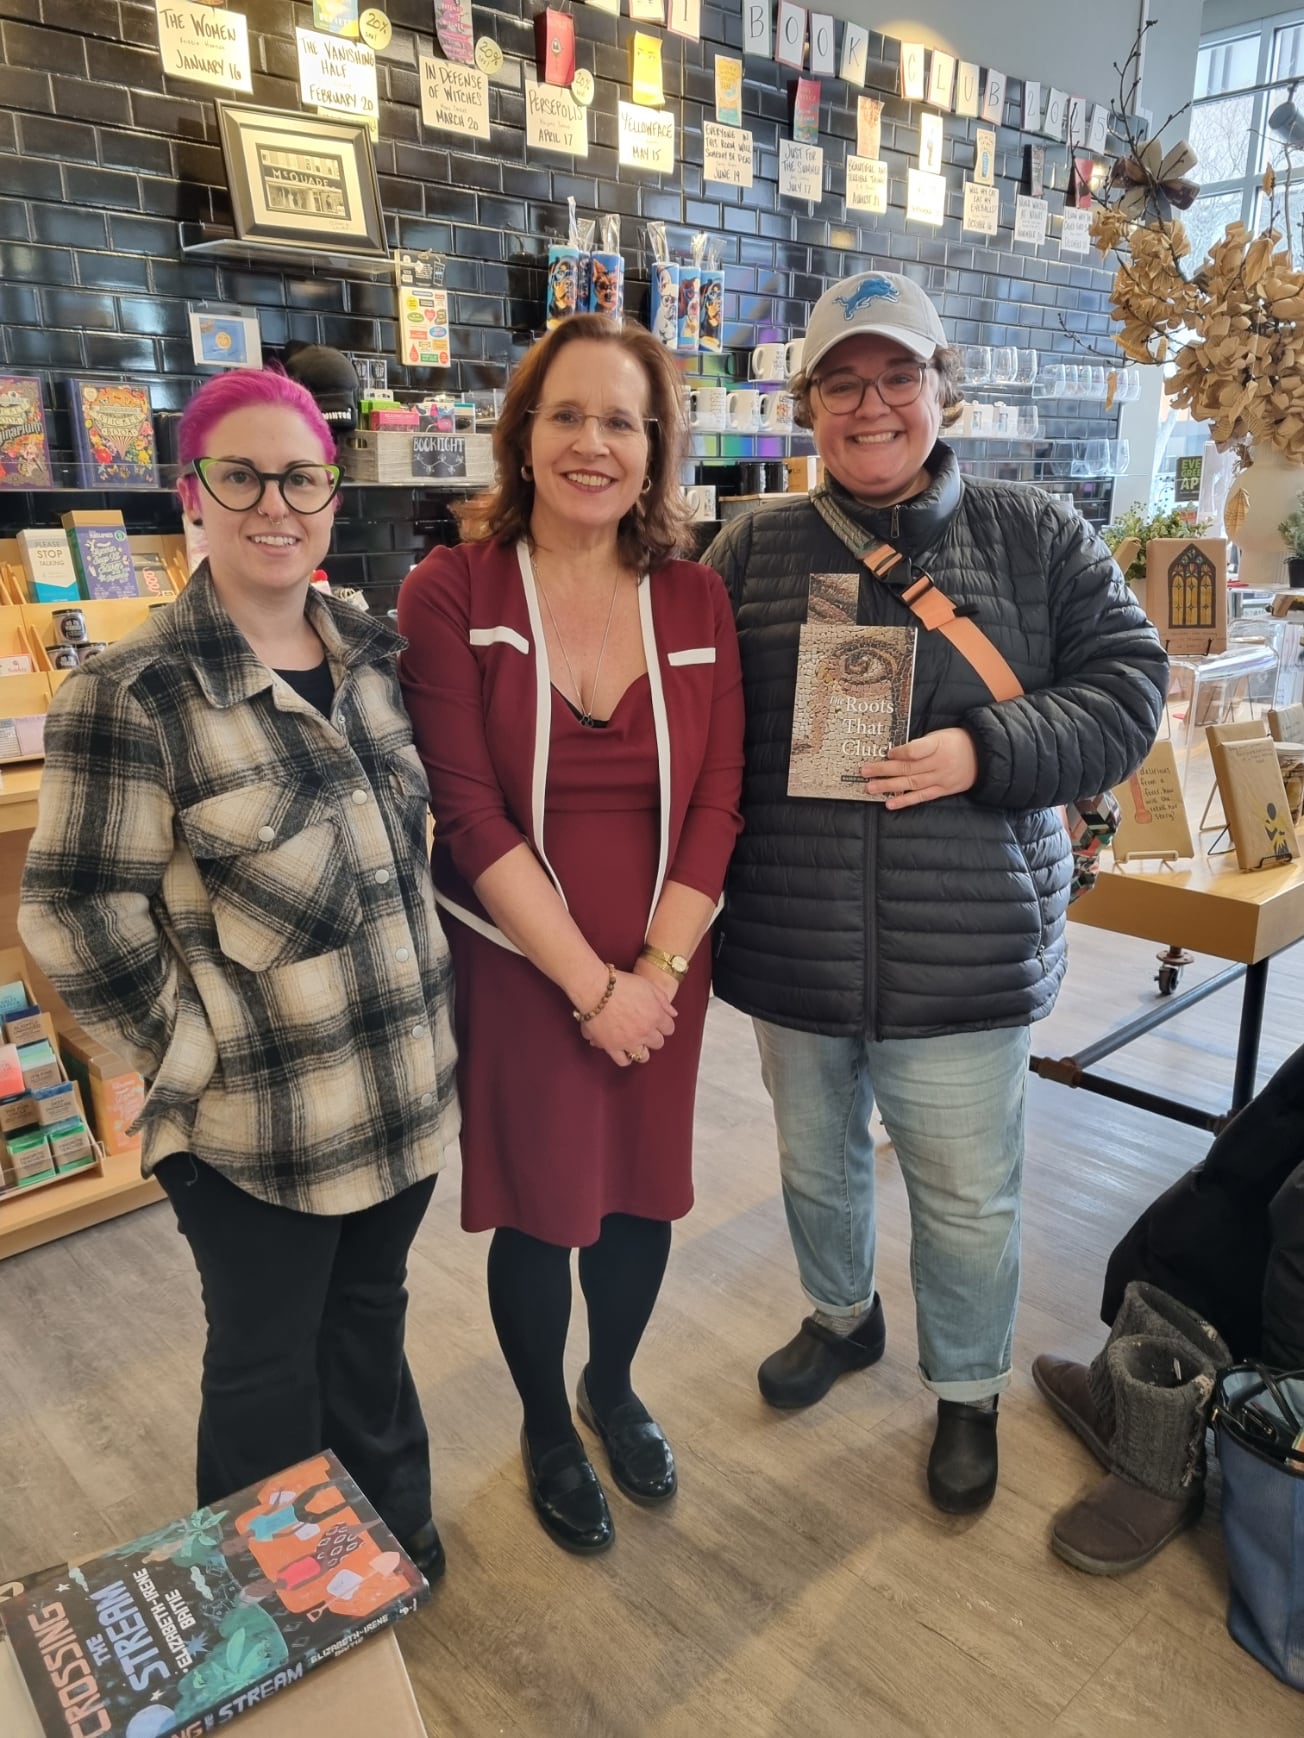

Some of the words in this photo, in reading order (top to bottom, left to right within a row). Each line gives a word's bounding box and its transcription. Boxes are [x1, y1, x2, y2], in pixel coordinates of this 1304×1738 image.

[159, 8, 185, 29] THE
[190, 13, 236, 41] WOMEN
[366, 12, 389, 35] 20%
[176, 49, 224, 76] JANUARY
[229, 62, 242, 81] 16
[302, 38, 318, 55] THE
[324, 40, 375, 67] VANISHING
[479, 41, 502, 66] 20%
[750, 5, 861, 67] BOOK
[908, 52, 1000, 107] CLUB
[320, 59, 347, 78] HALF
[425, 62, 436, 80] IN
[439, 67, 482, 90] DEFENSE
[310, 84, 357, 108] FEBRUARY
[360, 96, 374, 111] 20
[428, 83, 439, 99] OF
[443, 85, 482, 106] WITCHES
[528, 89, 583, 121] PERSEPOLIS
[435, 109, 465, 127] MARCH
[467, 116, 479, 131] 20
[622, 112, 672, 139] YELLOWFACE
[538, 128, 561, 143] APRIL
[564, 133, 573, 146] 17
[632, 144, 649, 160] MAY
[652, 148, 662, 161] 15
[785, 144, 802, 159] JUST
[714, 168, 730, 180] JUNE
[782, 160, 795, 172] THE
[787, 182, 802, 193] JULY
[37, 549, 63, 559] STOP
[845, 696, 895, 714] Roots
[843, 718, 884, 736] That
[132, 1567, 193, 1670] ELIZABETH-IRENE
[164, 1588, 197, 1631] BAITIE
[89, 1579, 171, 1693] STREAM
[86, 1633, 113, 1667] THE
[27, 1601, 112, 1738] CROSSING
[218, 1662, 304, 1724] STREAM
